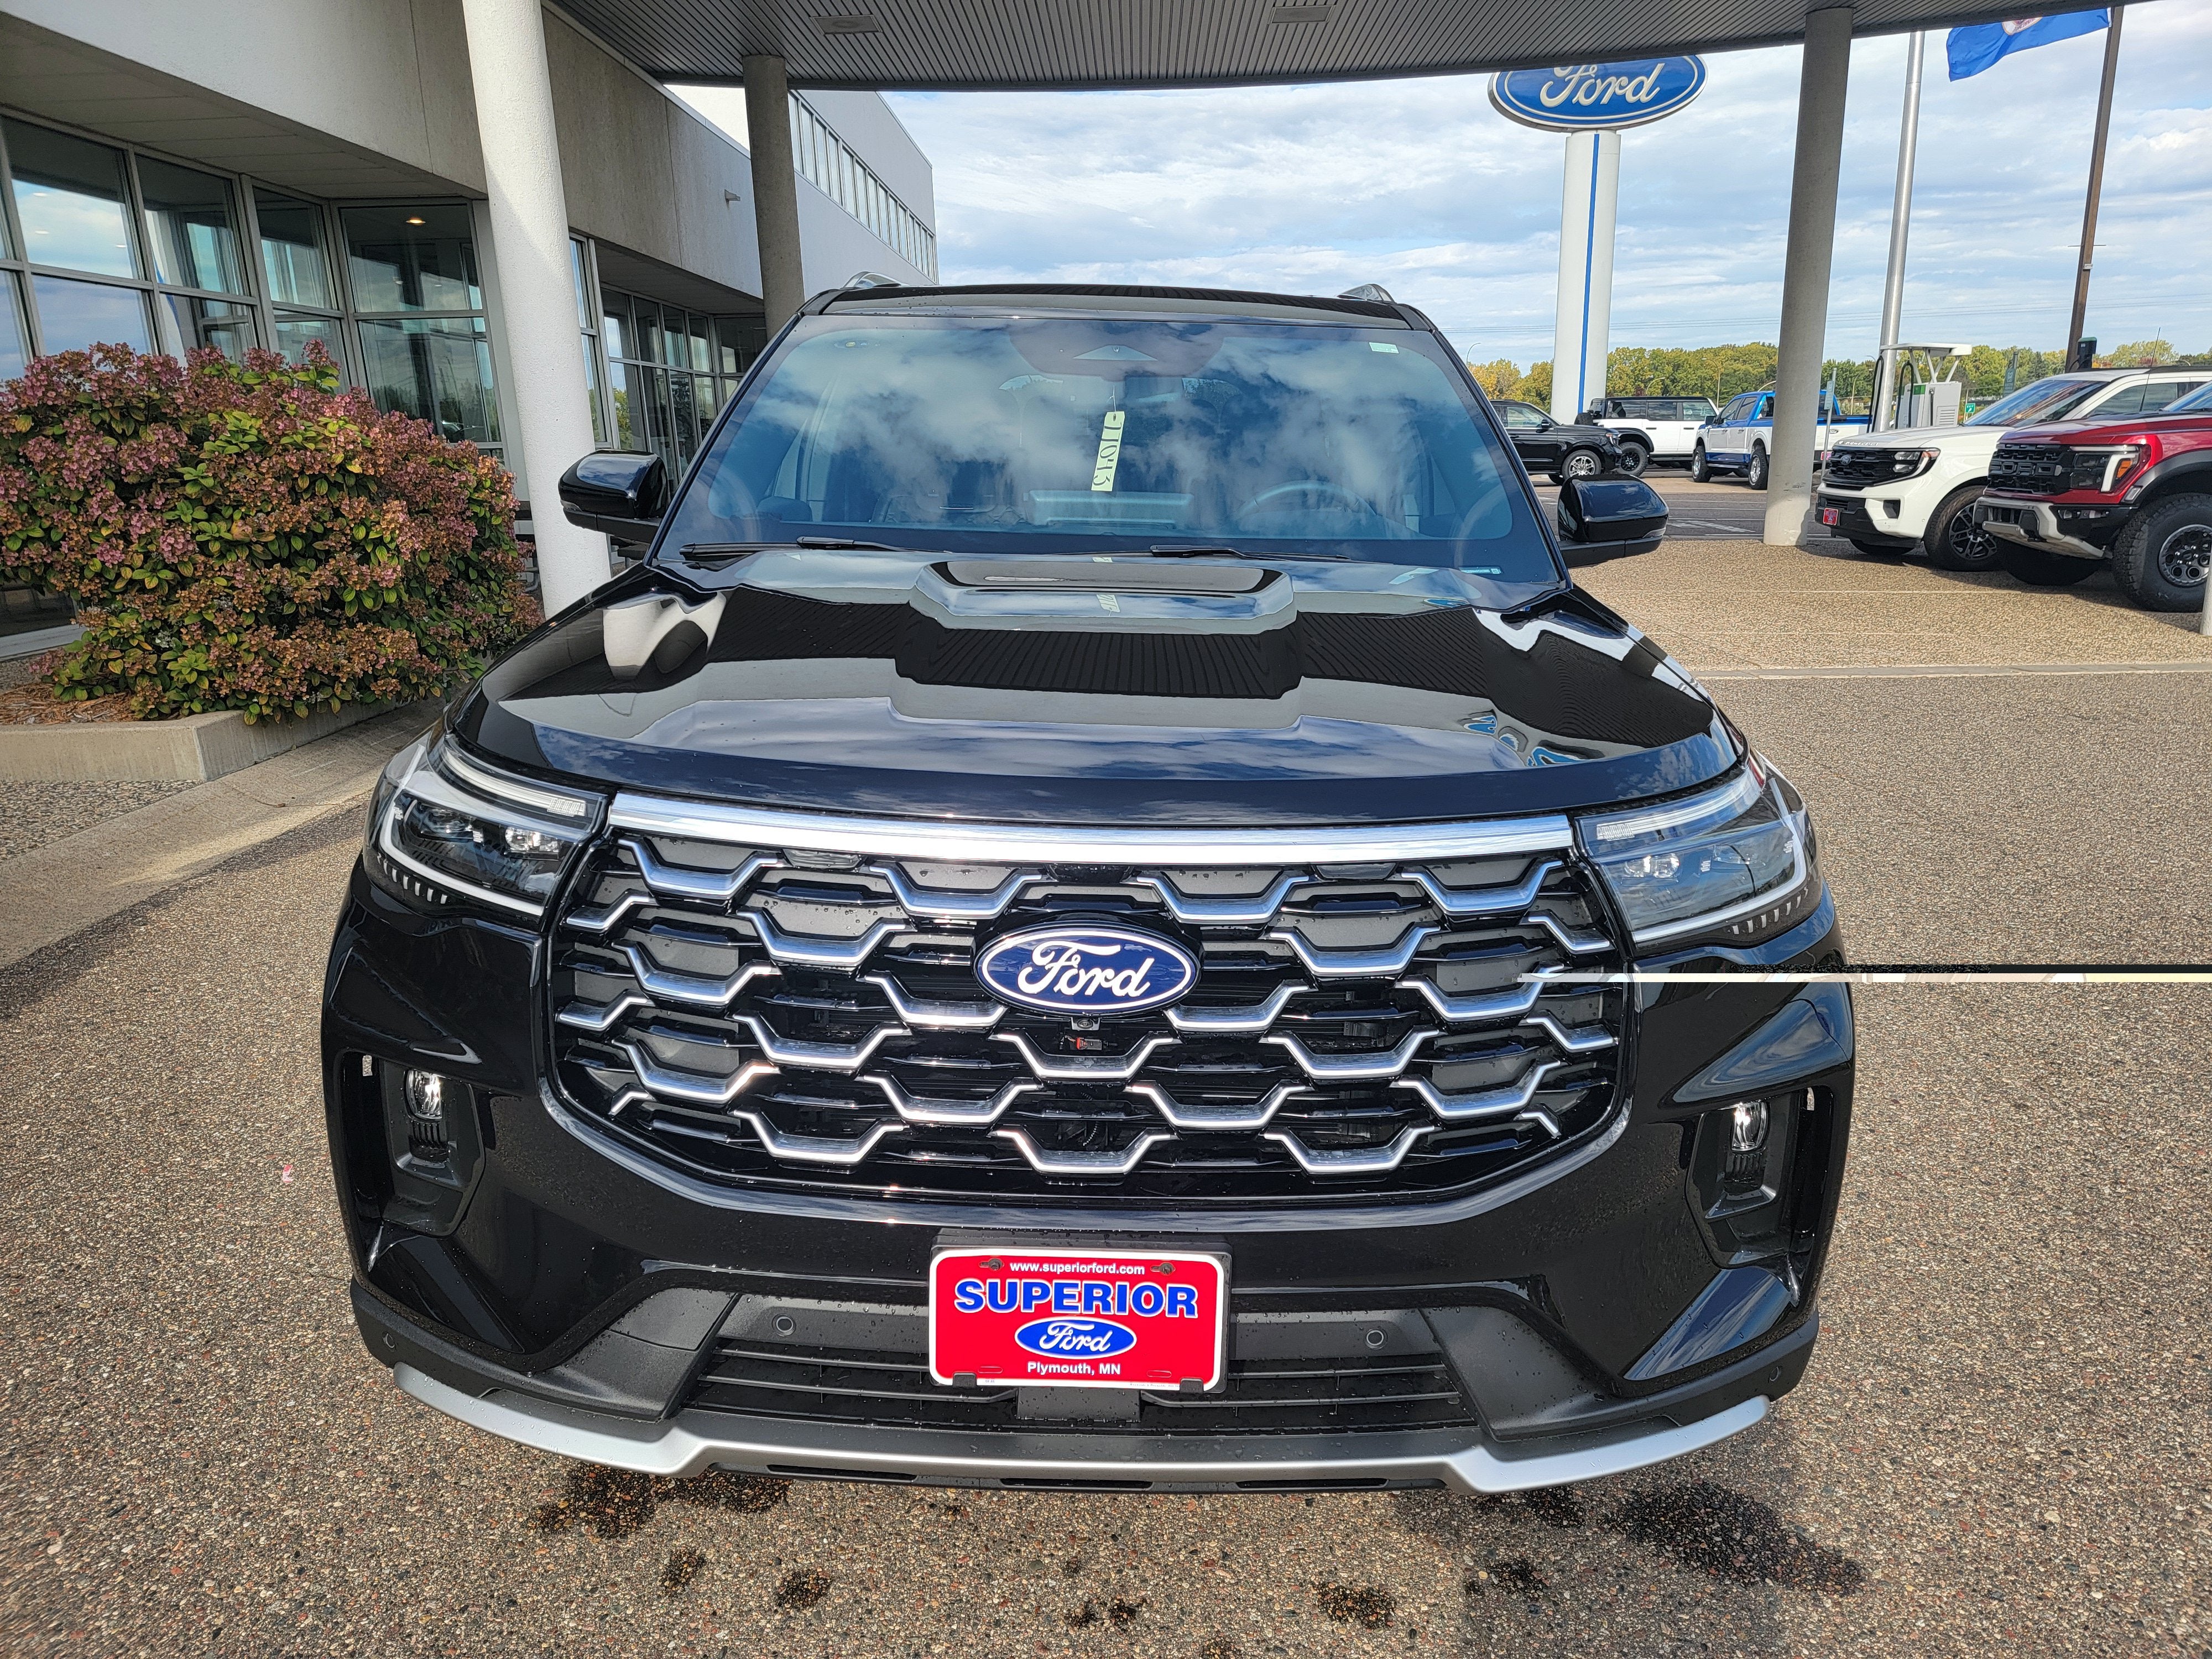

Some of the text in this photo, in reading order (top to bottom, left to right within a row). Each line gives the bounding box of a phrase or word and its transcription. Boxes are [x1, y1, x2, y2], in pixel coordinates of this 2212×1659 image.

[1540, 63, 1665, 108] Ford
[1018, 940, 1155, 997] Ford
[1010, 1262, 1145, 1275] www.superiorford.com
[954, 1277, 1198, 1319] SUPERIOR
[1039, 1322, 1113, 1352] Ford
[1027, 1361, 1121, 1375] Plymouth, MN
